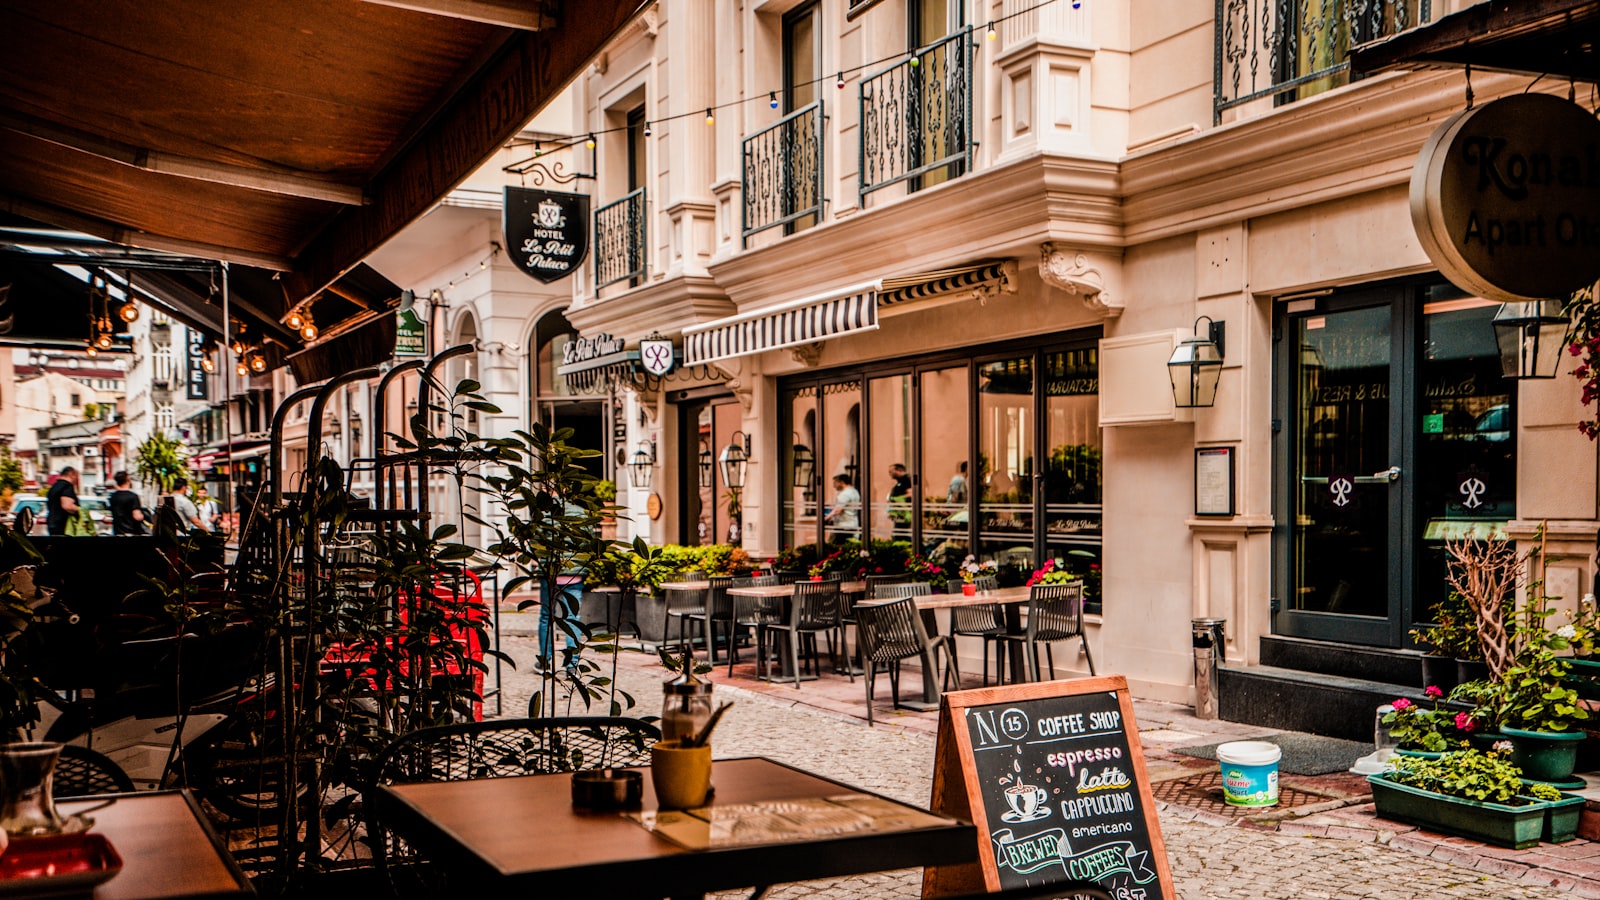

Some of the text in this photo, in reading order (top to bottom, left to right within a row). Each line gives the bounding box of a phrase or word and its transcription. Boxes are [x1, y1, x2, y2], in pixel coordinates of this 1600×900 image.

[521, 239, 575, 256] Le Petit
[533, 229, 565, 240] HOTEL
[1464, 211, 1546, 256] Apart
[526, 254, 569, 271] Palace
[562, 333, 622, 365] Le Petit Palace
[189, 331, 204, 397] HOTEL
[1006, 716, 1022, 732] 15
[1038, 713, 1085, 737] COFFEE
[1090, 711, 1120, 730] SHOP
[1047, 747, 1122, 778] espresso
[1077, 767, 1131, 791] latte
[1061, 792, 1134, 820] CAPPUCCINO
[1072, 821, 1132, 838] americano
[1007, 835, 1059, 867] BREWED
[1070, 847, 1126, 880] COFFEES
